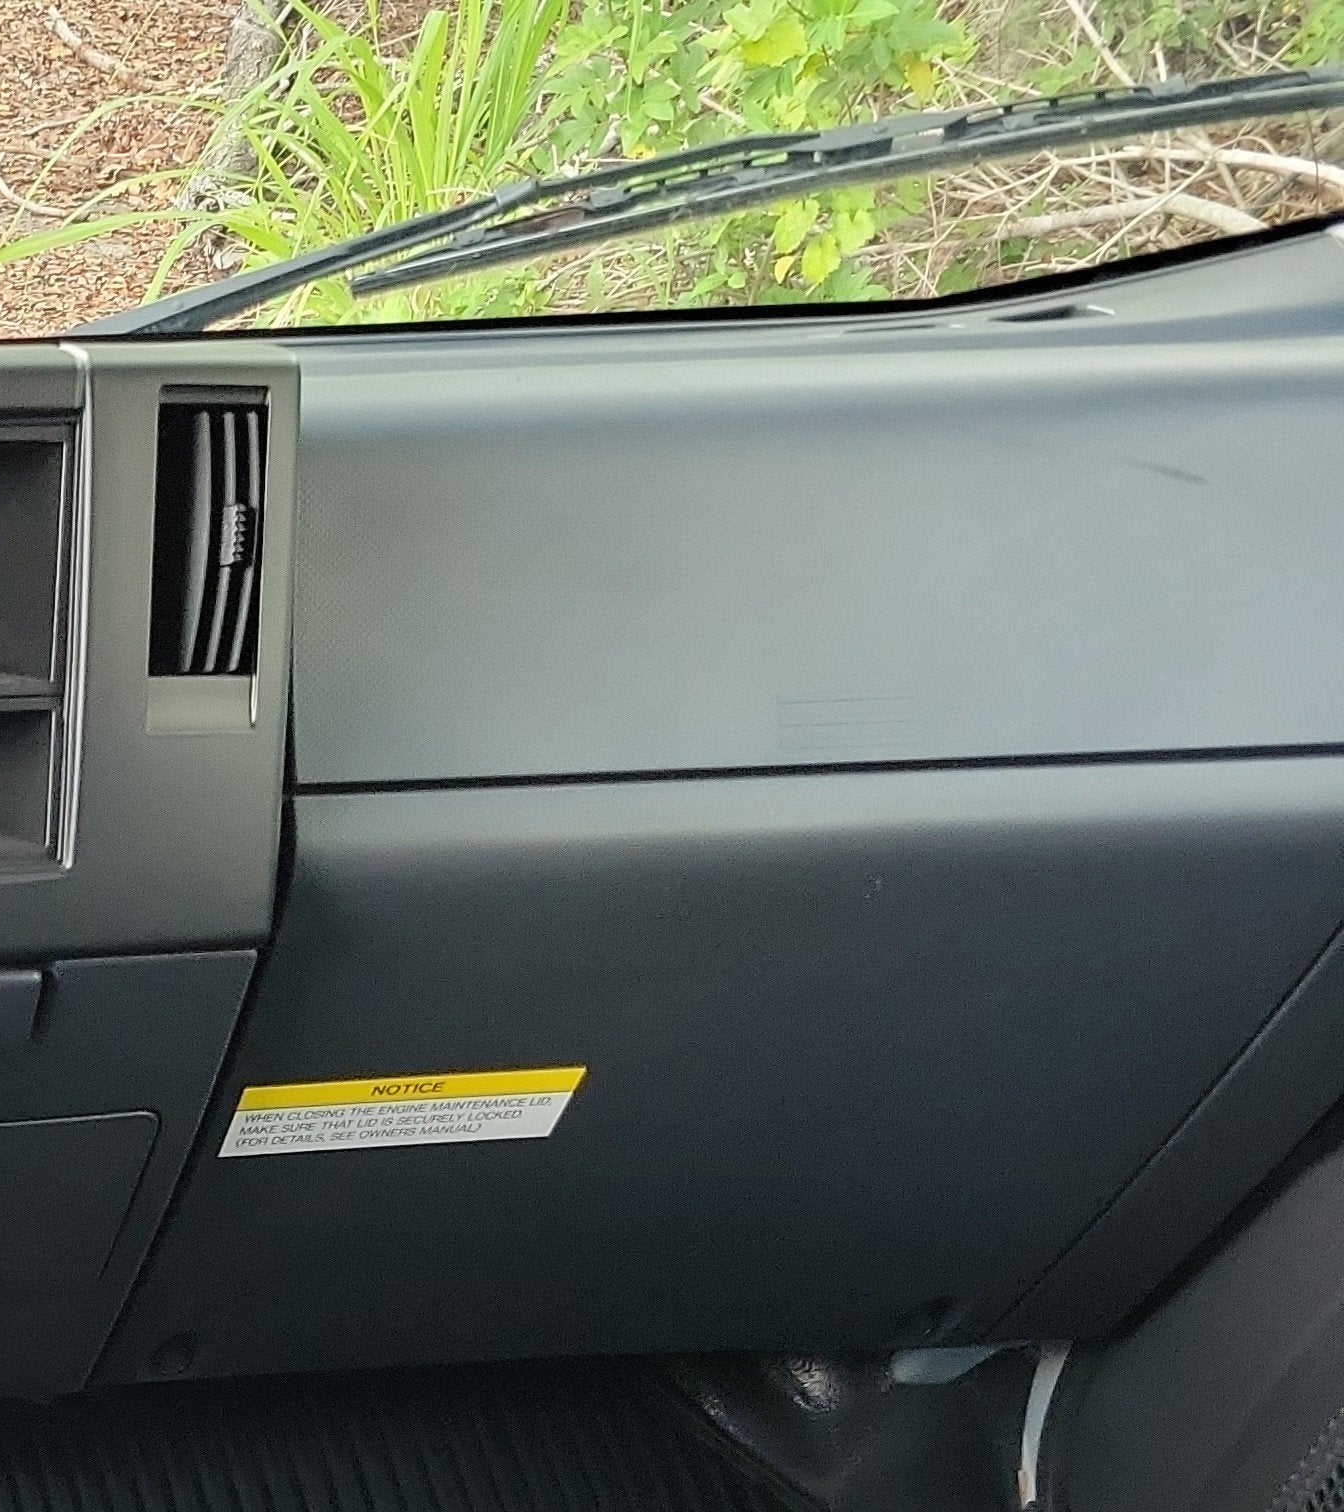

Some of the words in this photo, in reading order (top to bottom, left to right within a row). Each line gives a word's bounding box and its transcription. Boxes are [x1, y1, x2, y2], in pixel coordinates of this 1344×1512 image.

[370, 1081, 445, 1096] NOTICE
[245, 1112, 283, 1123] WHEN
[288, 1109, 344, 1121] CLOSING
[351, 1106, 373, 1117] THE
[378, 1102, 428, 1115] ENGINE
[431, 1098, 524, 1112] MAINTENANCE
[239, 1124, 278, 1135] MAKE
[283, 1121, 314, 1132] SURE
[322, 1119, 352, 1130] THAT
[357, 1117, 377, 1127] LID
[381, 1116, 392, 1126] IS
[397, 1113, 462, 1126] SECURELY
[330, 1130, 354, 1141] SEE
